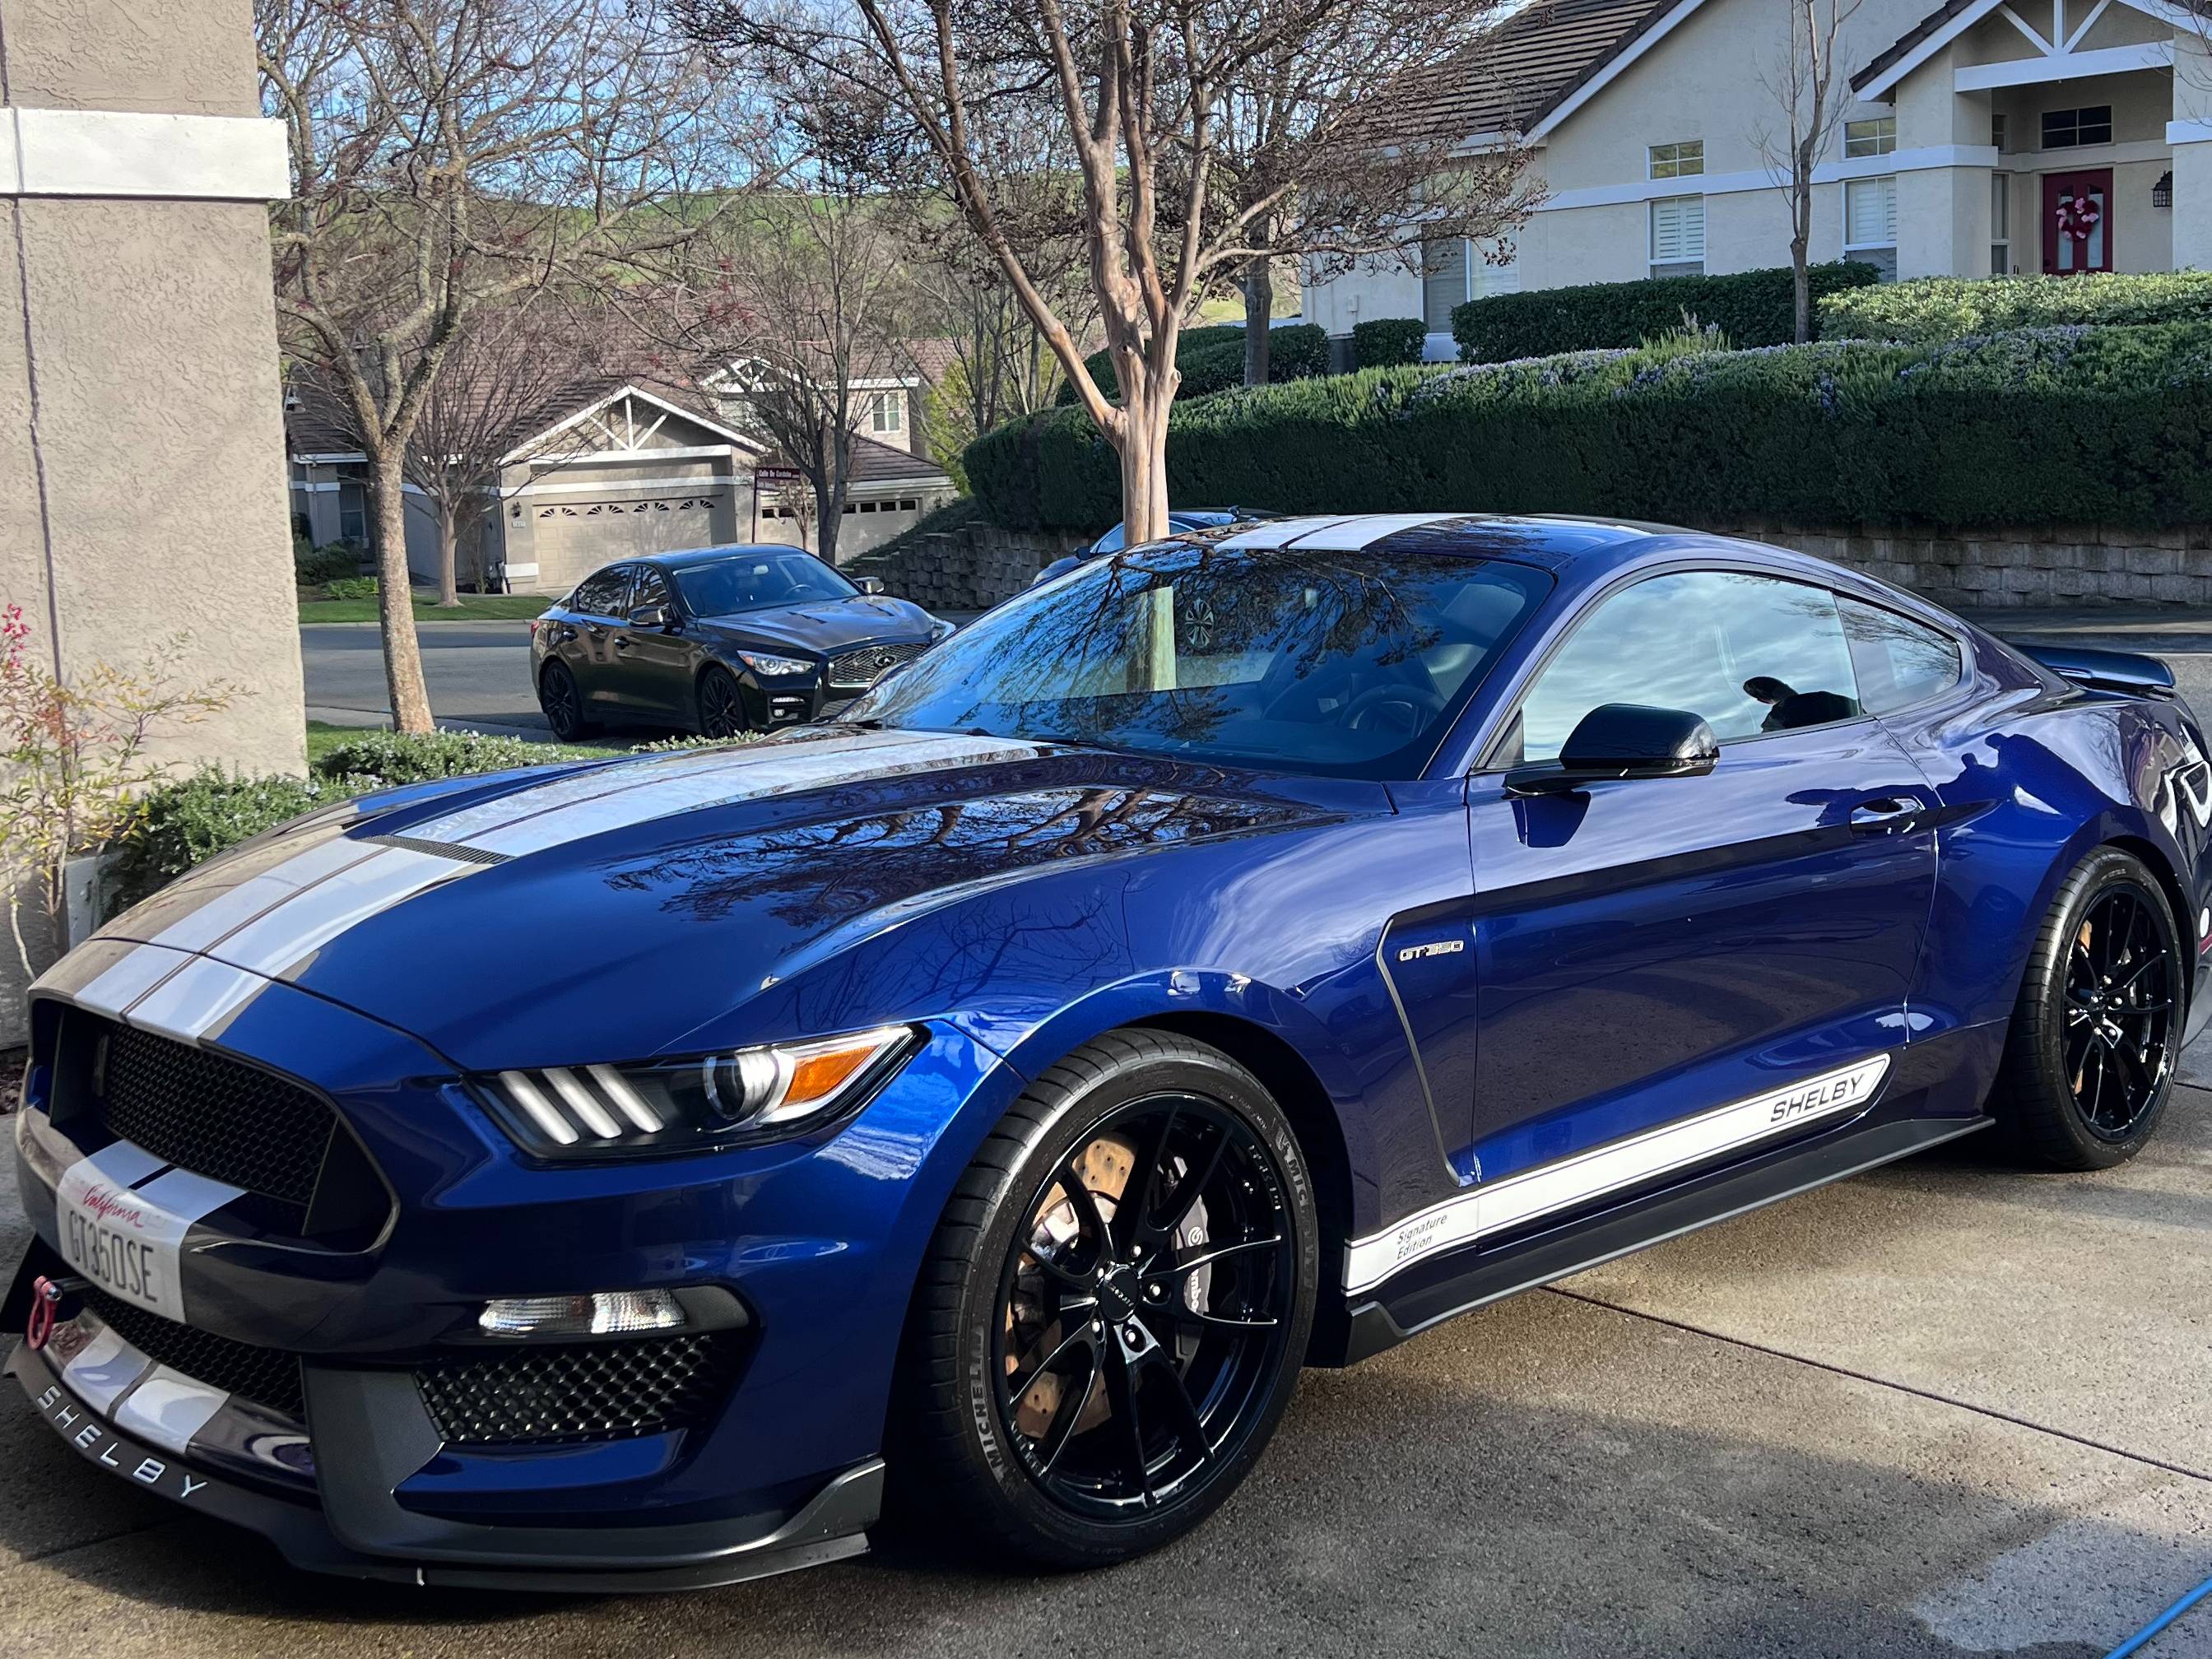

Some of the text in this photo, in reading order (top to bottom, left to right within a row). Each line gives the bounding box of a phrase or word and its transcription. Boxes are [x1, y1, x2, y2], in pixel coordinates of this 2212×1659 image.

[1770, 1073, 1866, 1122] SHELBY
[84, 1183, 145, 1228] California
[1396, 1235, 1433, 1260] Edition
[1397, 1214, 1448, 1245] Signature
[37, 1385, 208, 1499] SHELBY
